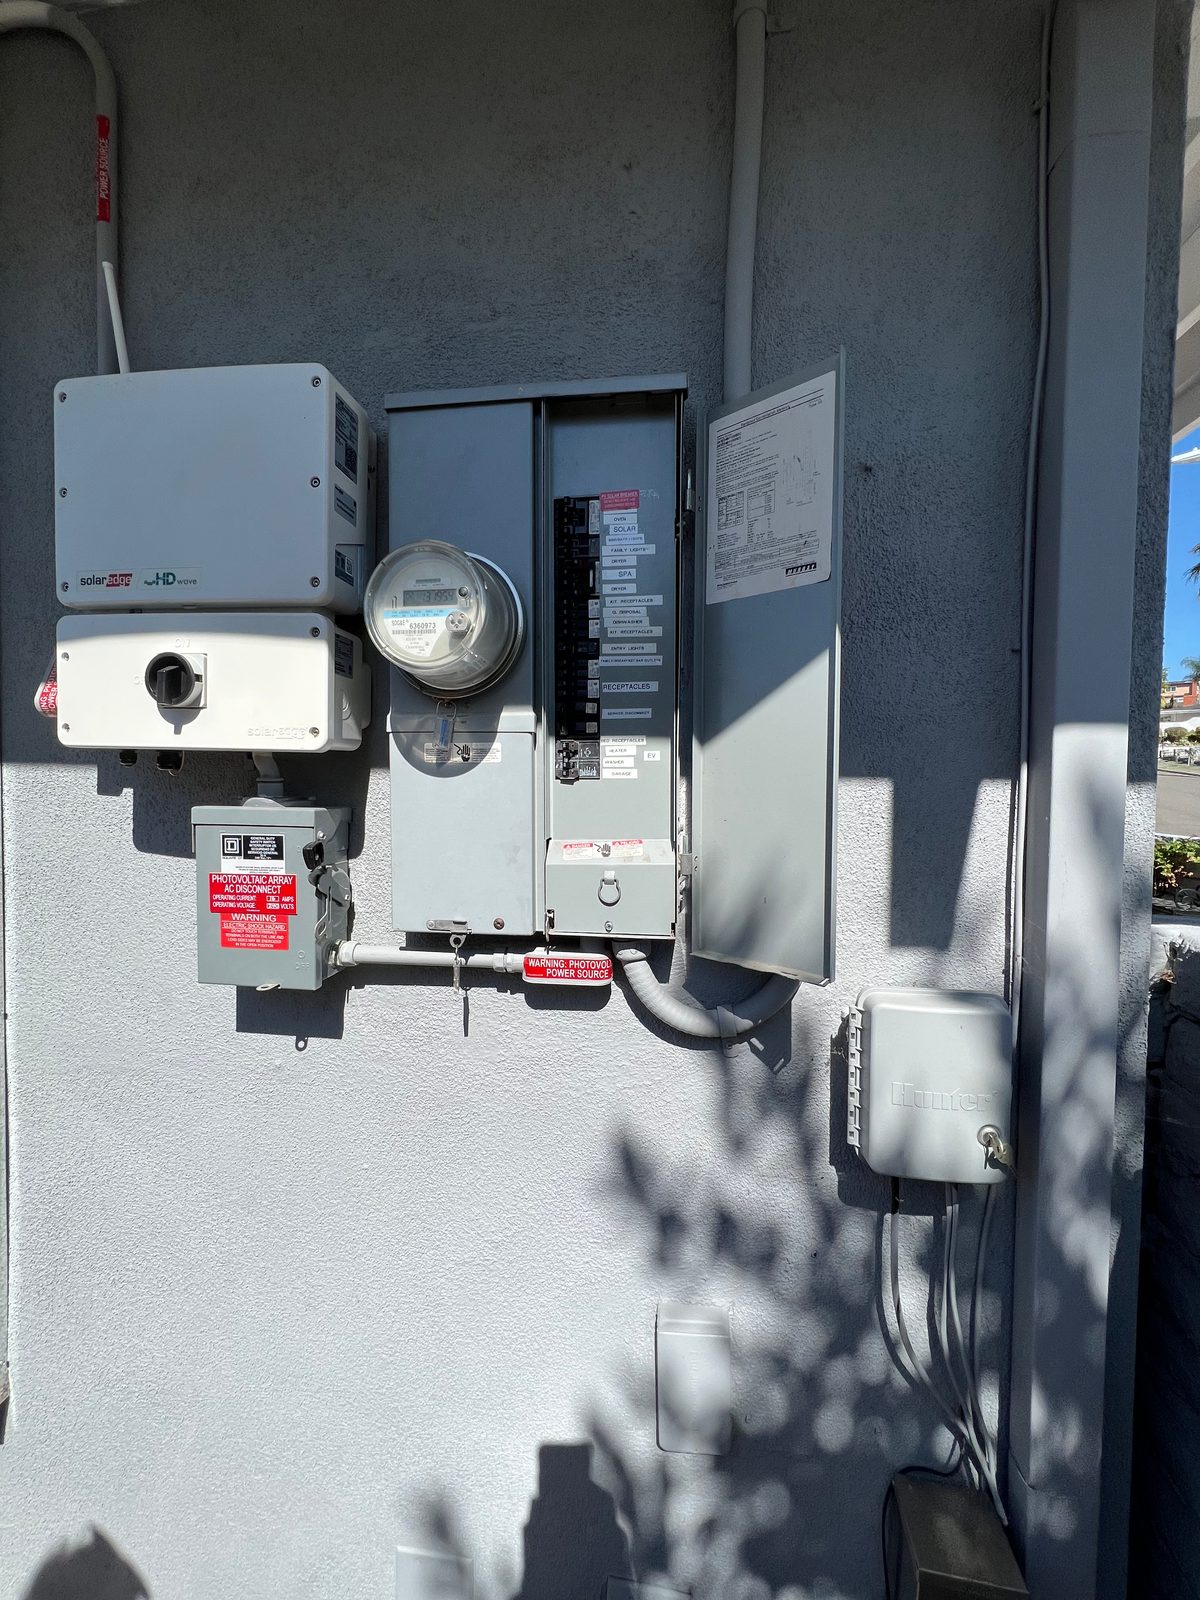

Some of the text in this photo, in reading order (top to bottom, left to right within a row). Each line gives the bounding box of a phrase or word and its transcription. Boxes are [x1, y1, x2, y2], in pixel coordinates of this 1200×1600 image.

[409, 622, 436, 630] 6360973
[212, 874, 293, 884] PHOTOVOLTAIC ARRAY
[224, 884, 281, 894] AC DISCONNECT
[231, 914, 277, 922] WARNING
[528, 958, 567, 968] WARNING:
[546, 969, 608, 978] POWER SOURCE
[891, 1081, 991, 1112] Hunter
